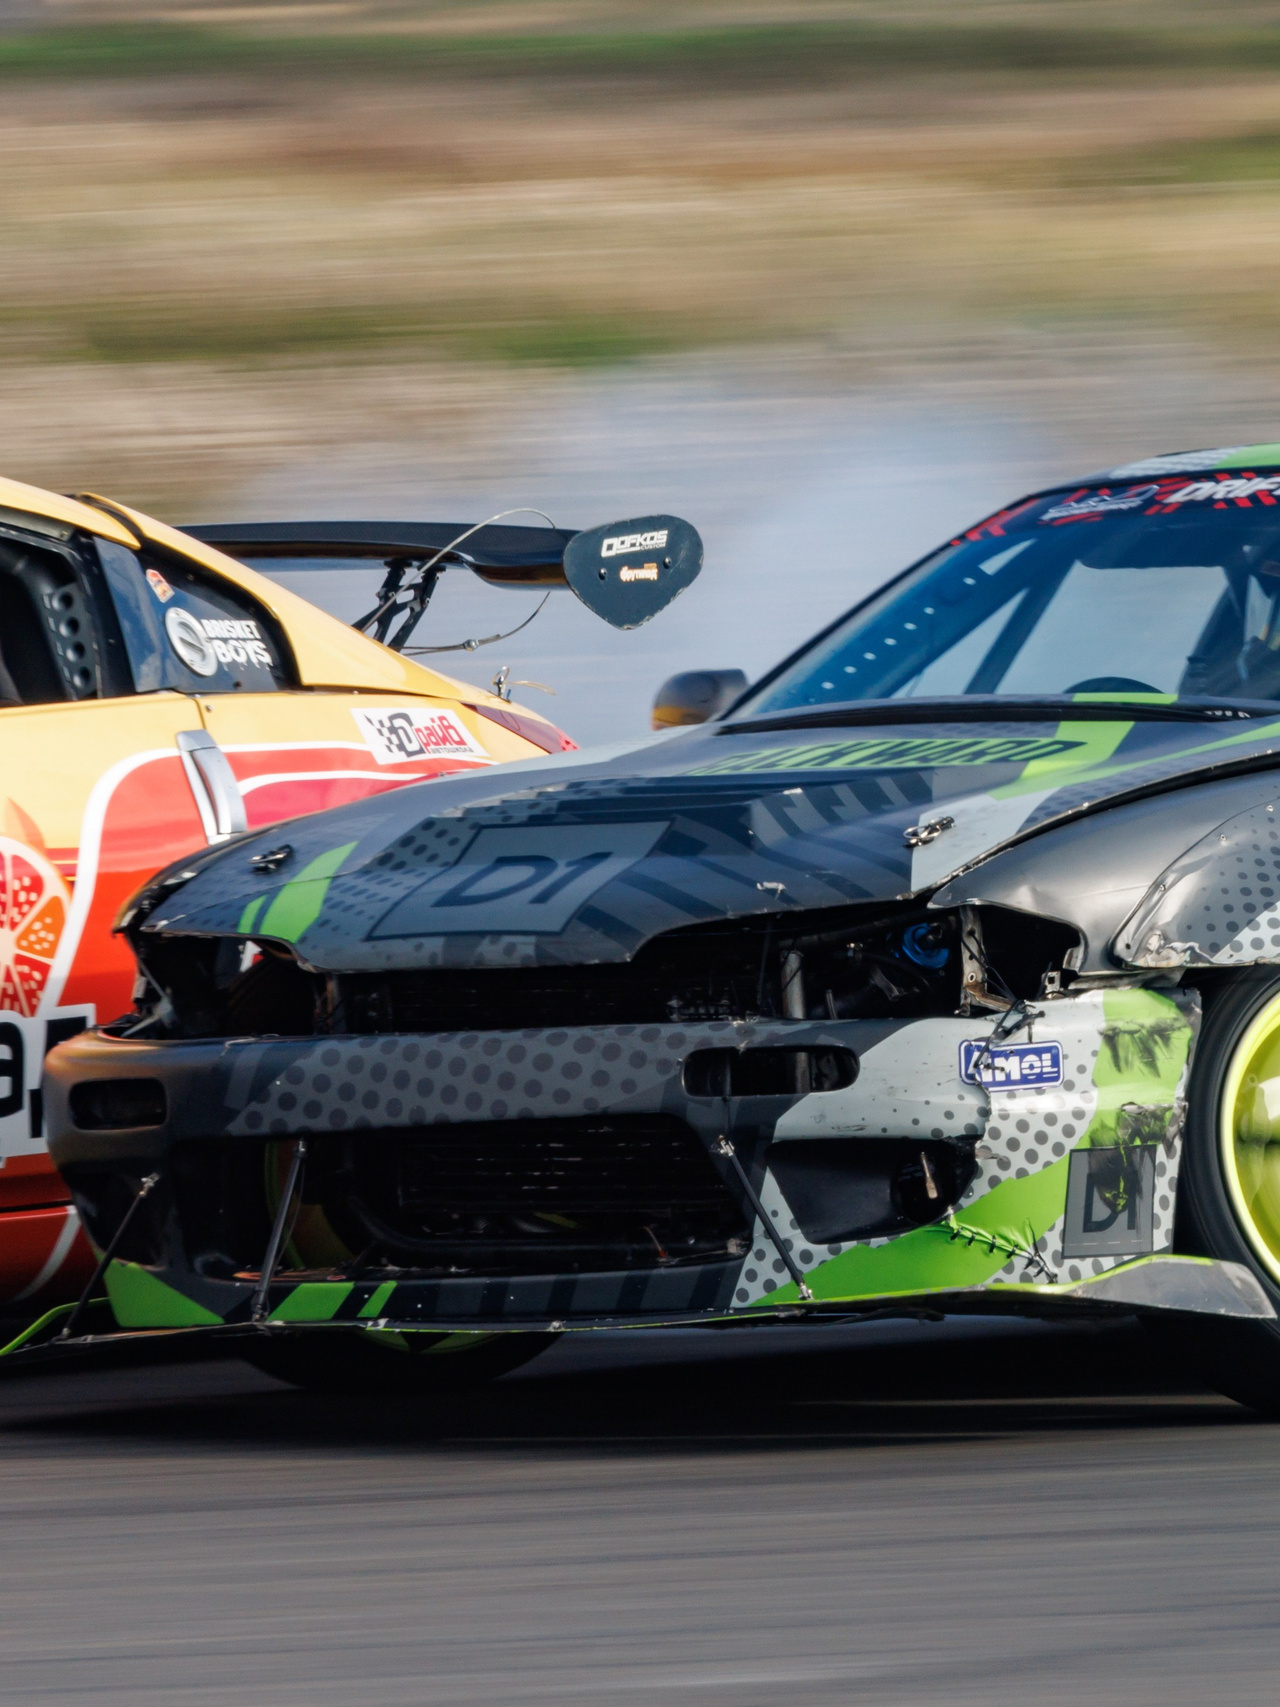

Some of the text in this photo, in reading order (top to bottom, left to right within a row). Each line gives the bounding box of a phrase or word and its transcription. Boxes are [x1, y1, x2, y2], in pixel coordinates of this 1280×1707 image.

[200, 619, 261, 639] BRISKET
[211, 639, 273, 668] BOYS
[430, 852, 614, 908] D1
